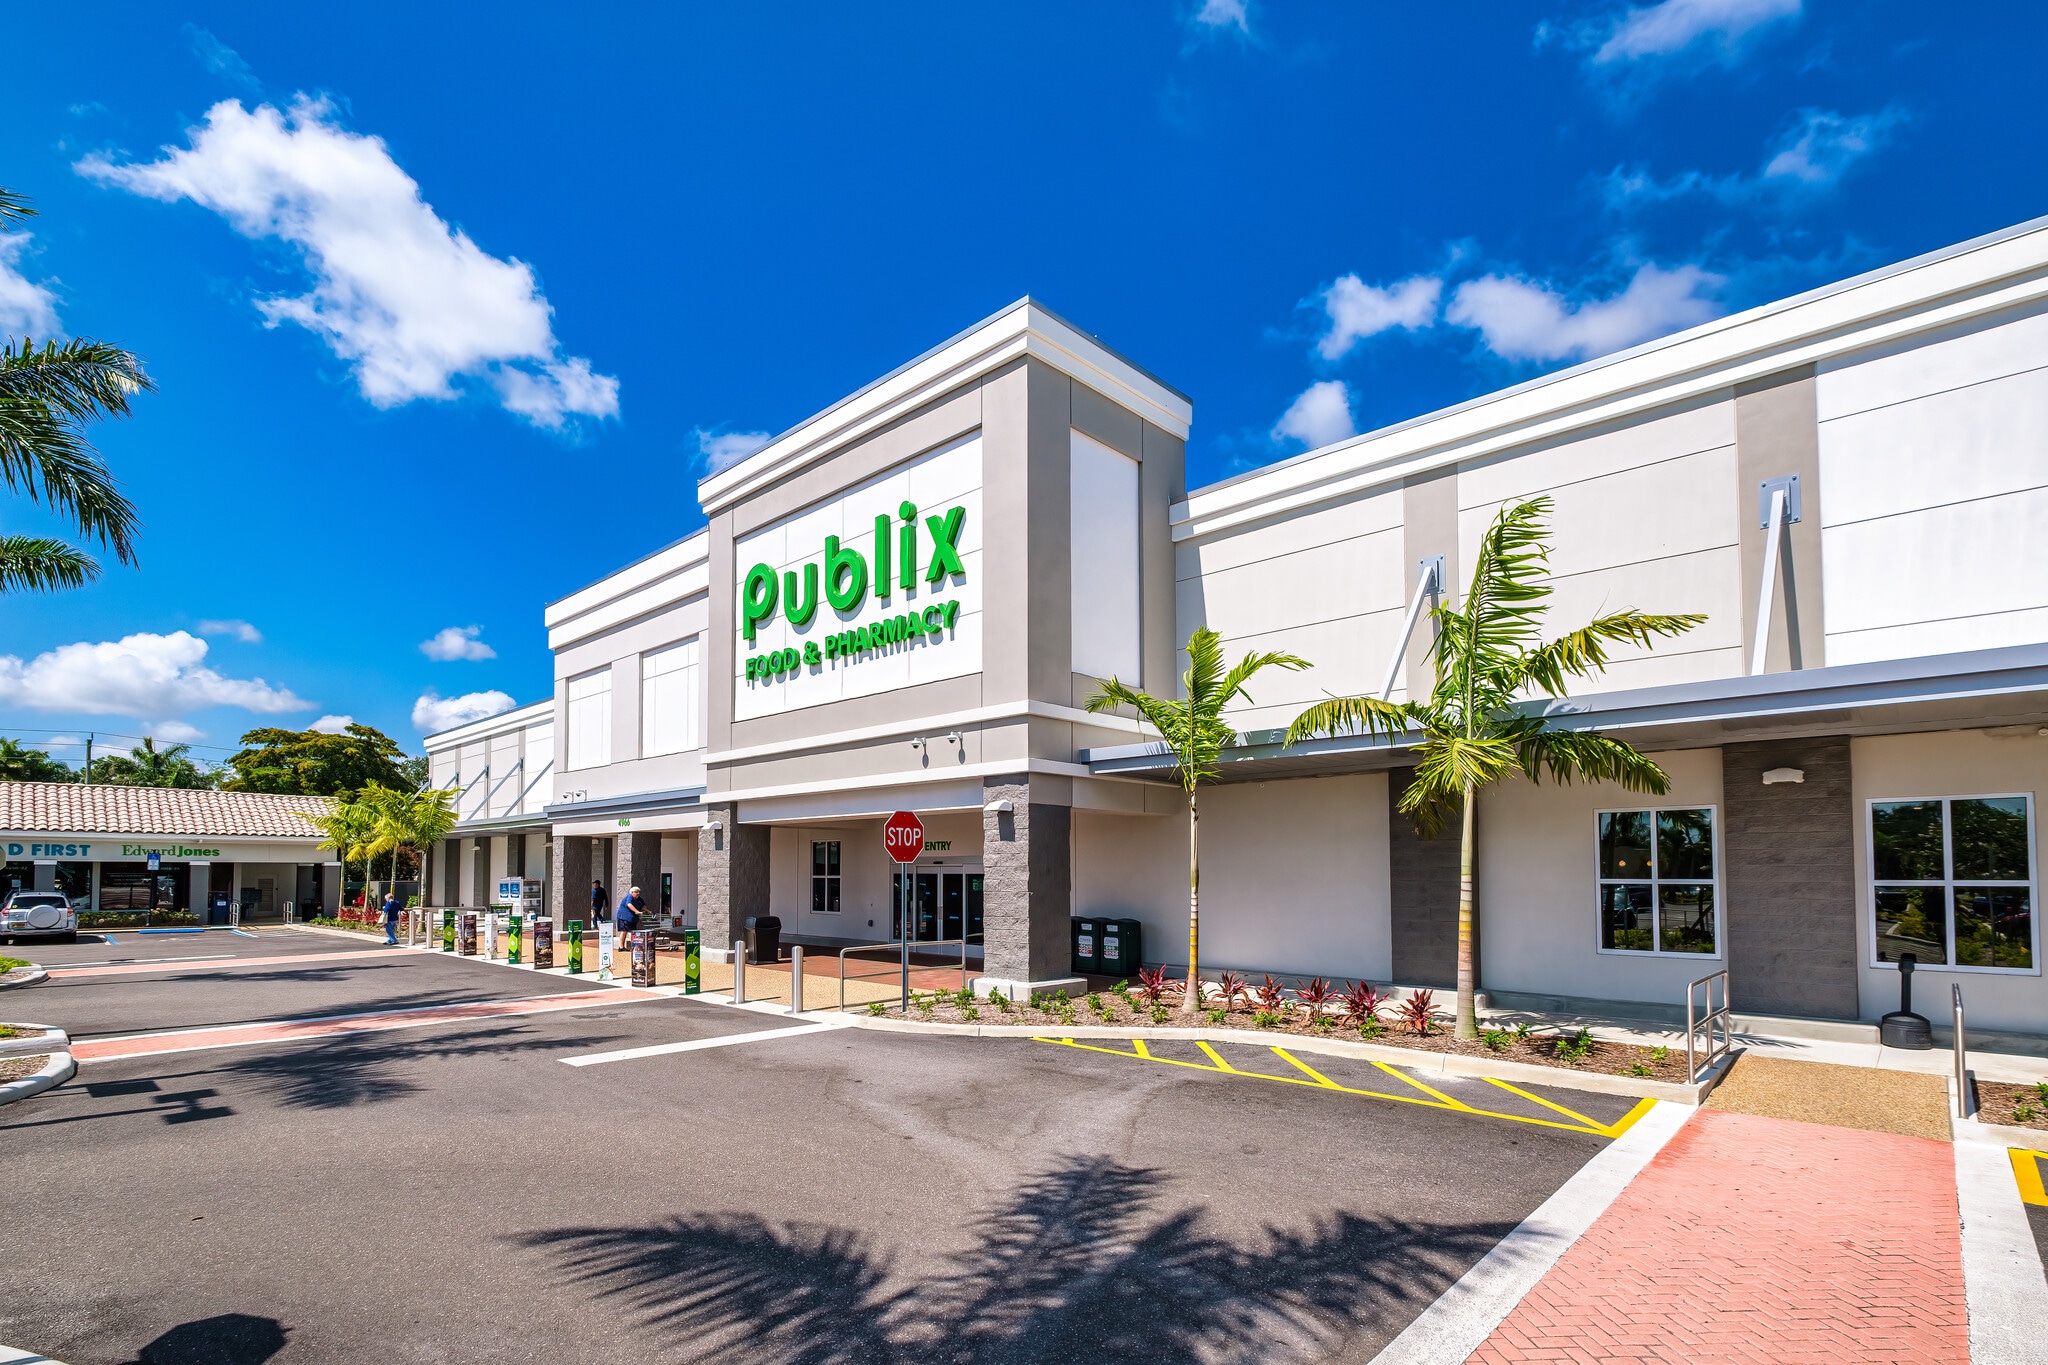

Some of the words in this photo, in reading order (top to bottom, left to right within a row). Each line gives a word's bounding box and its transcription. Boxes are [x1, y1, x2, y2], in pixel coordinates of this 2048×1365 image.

[743, 501, 966, 640] Publix
[746, 648, 800, 680] FOOD
[803, 641, 821, 665] &
[825, 600, 960, 659] PHARMACY
[888, 827, 921, 846] STOP
[925, 841, 952, 851] ENTRY
[0, 844, 24, 856] D
[31, 844, 91, 856] FIRST
